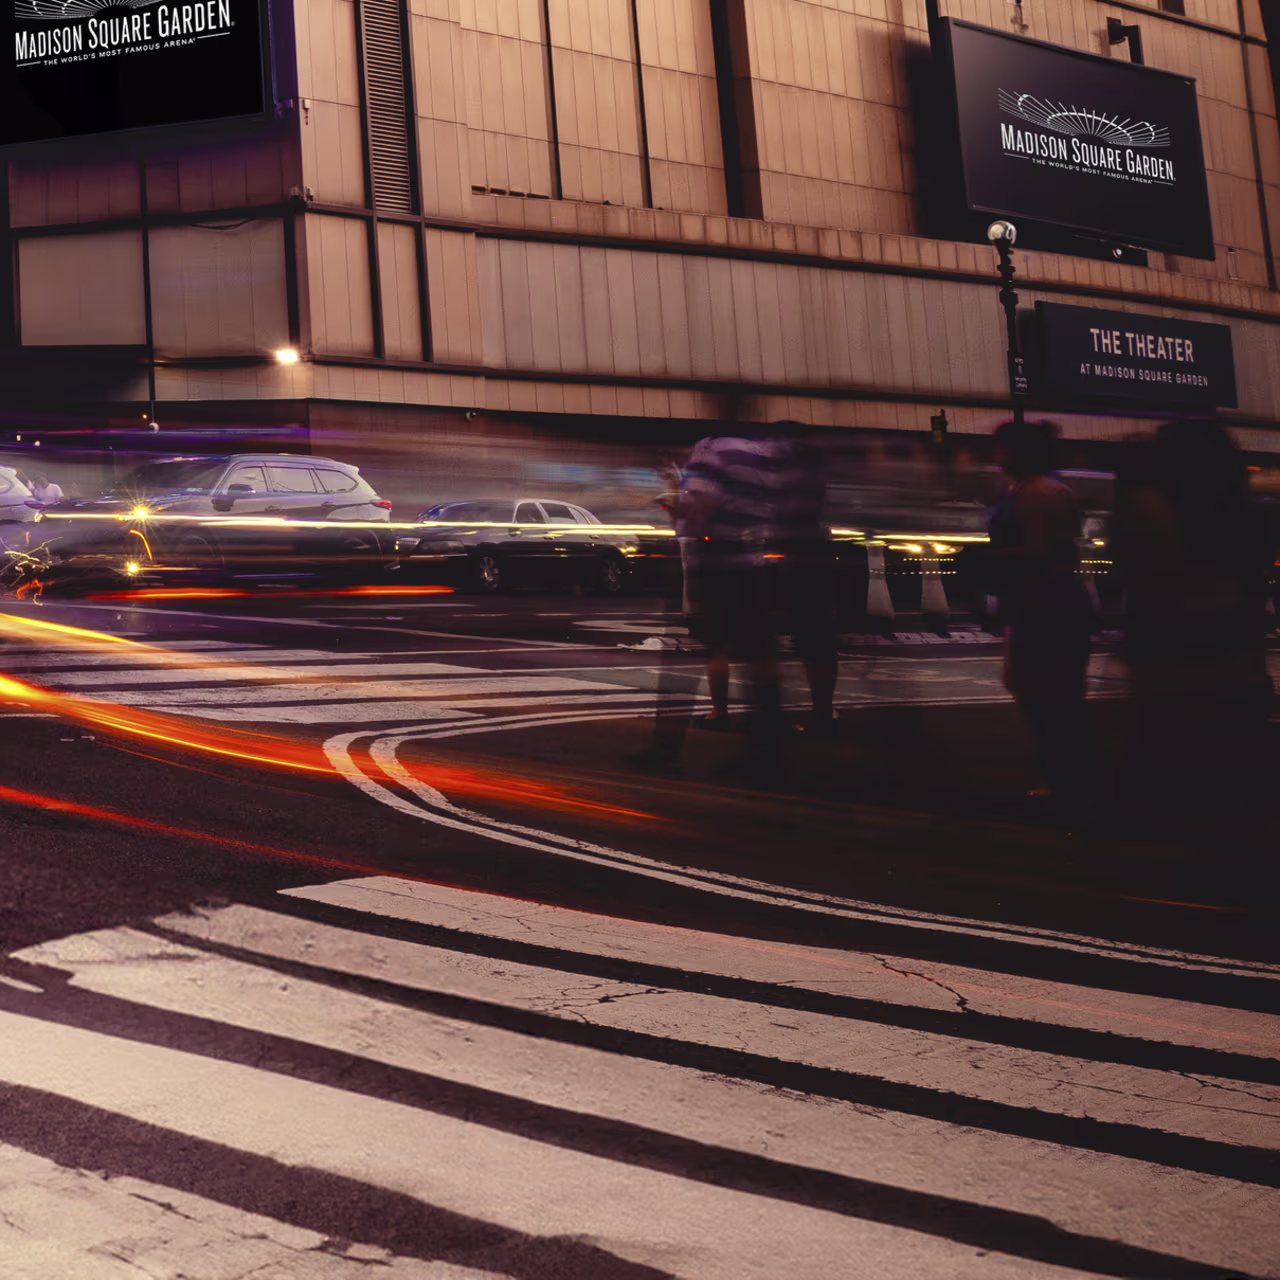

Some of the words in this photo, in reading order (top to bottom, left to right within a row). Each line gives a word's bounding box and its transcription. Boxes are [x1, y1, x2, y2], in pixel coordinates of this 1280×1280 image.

[15, 24, 82, 61] MADISON
[88, 12, 152, 49] SQUARE
[99, 48, 122, 58] MOST
[125, 43, 161, 54] FAMOUS
[1000, 123, 1067, 161] MADISON
[1072, 138, 1123, 171] SQUARE
[1090, 328, 1122, 356] THE
[1125, 331, 1195, 363] THEATER
[1080, 363, 1091, 375] AT
[1094, 364, 1136, 380] MADISON
[1138, 369, 1173, 383] SQUARE
[1176, 372, 1208, 387] GARDEN
